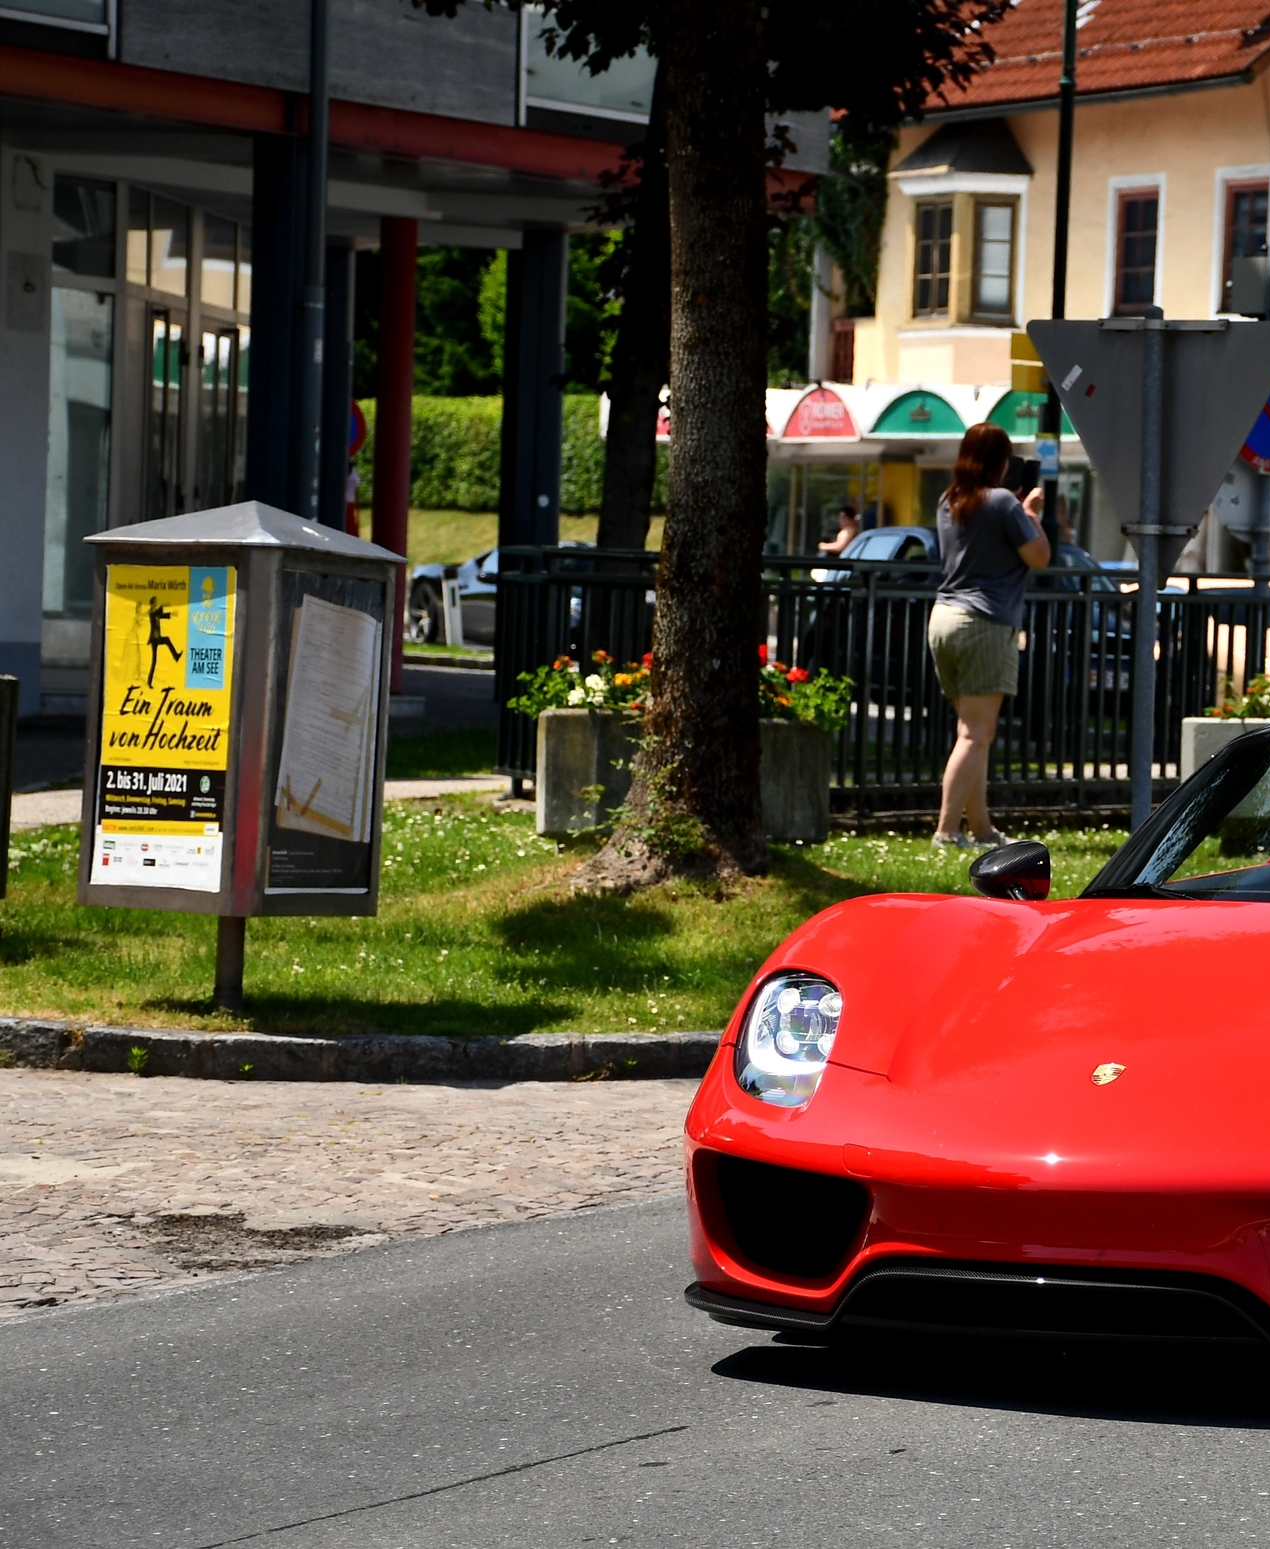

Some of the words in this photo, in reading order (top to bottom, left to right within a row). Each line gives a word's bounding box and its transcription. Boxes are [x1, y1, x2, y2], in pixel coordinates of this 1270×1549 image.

[148, 579, 166, 590] Maria
[167, 579, 186, 590] Wörth
[190, 647, 222, 661] THEATER
[191, 661, 204, 674] AM
[206, 662, 219, 675] SEE
[119, 684, 151, 715] Ein
[154, 686, 212, 717] Traum
[109, 731, 139, 748] von
[141, 719, 221, 751] Hochzeit
[106, 771, 115, 789] 2.
[117, 770, 131, 790] bis
[132, 771, 147, 791] 31.
[147, 772, 164, 795] Juli
[165, 773, 187, 793] 2021
